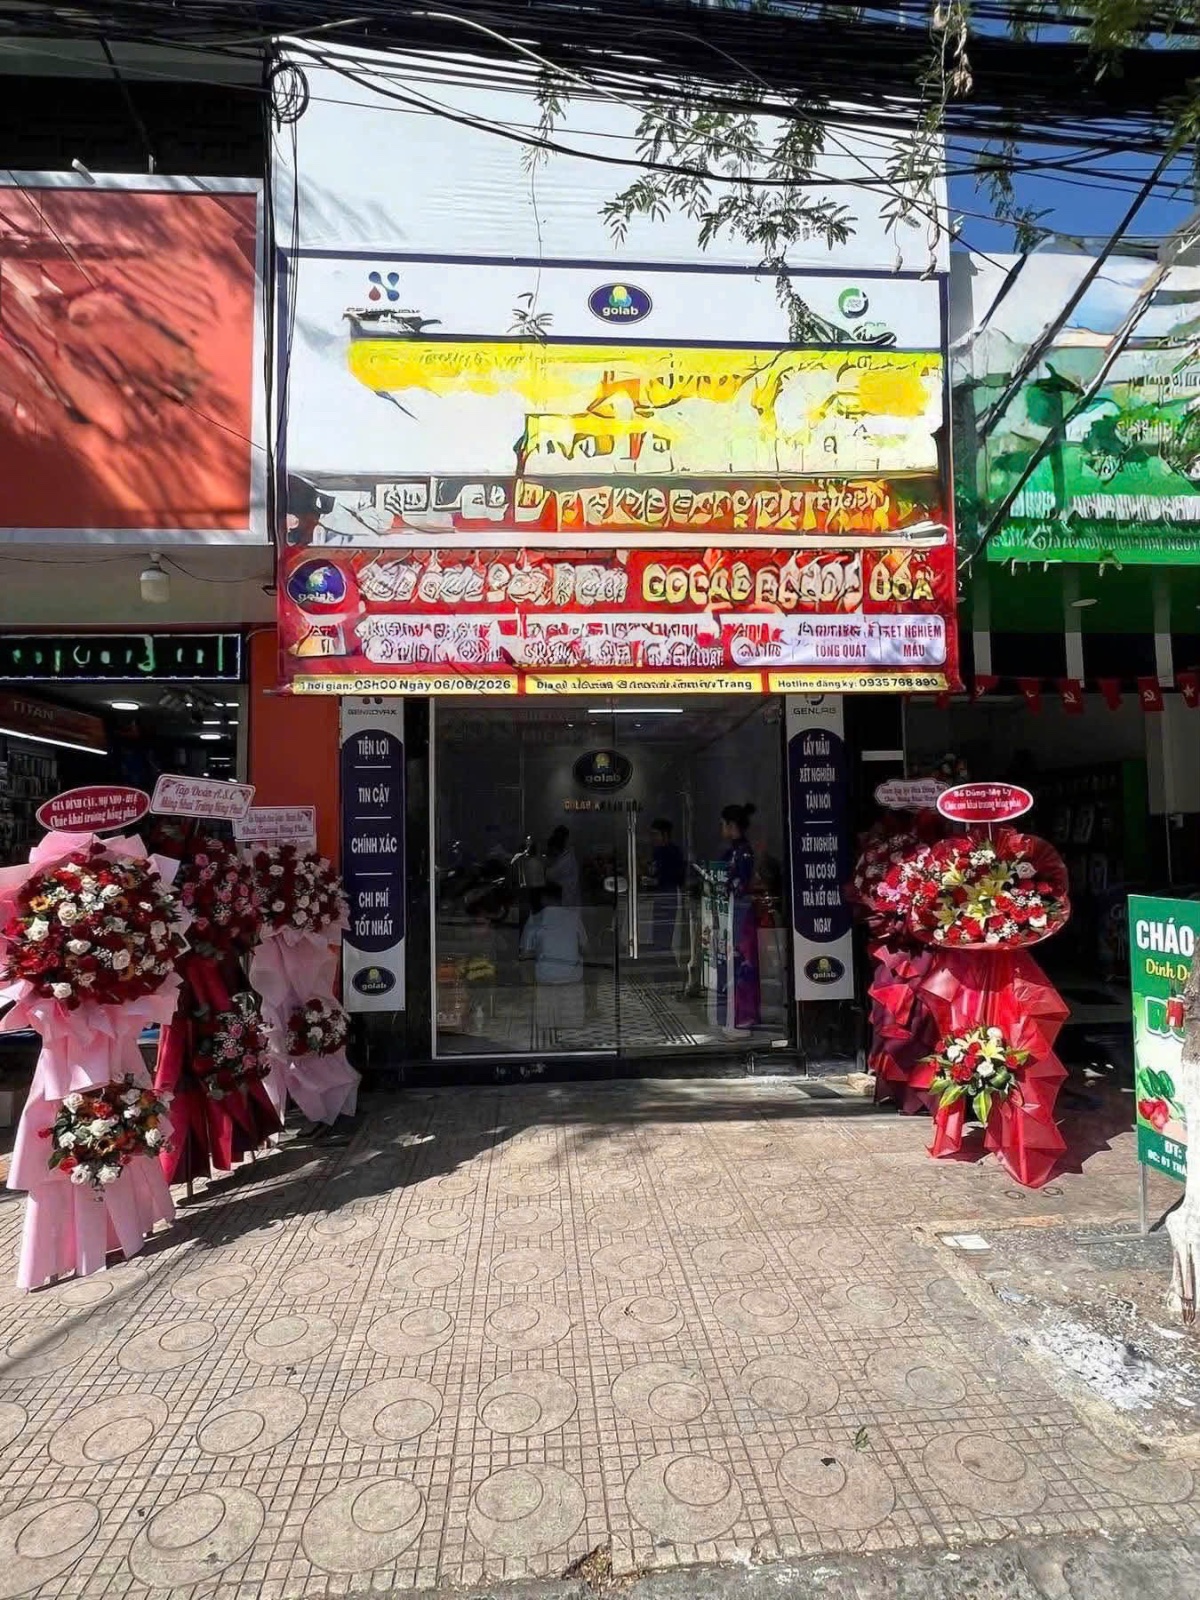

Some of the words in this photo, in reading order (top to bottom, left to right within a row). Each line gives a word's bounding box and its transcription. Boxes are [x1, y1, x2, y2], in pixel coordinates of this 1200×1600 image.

[602, 306, 639, 316] golab
[326, 682, 352, 691] gian:
[400, 680, 431, 692] Ngày
[718, 680, 752, 690] Trang
[778, 680, 814, 688] Hotline
[859, 678, 890, 687] 0935
[358, 736, 374, 760] TIỆN
[376, 737, 389, 760] LỢI
[358, 787, 370, 803] TIN
[372, 783, 390, 808] CẬY
[1002, 788, 1012, 796] Ly
[50, 814, 68, 828] Chúc
[68, 812, 84, 825] khai
[352, 833, 378, 854] CHÍNH
[379, 833, 398, 854] XÁC
[358, 892, 374, 908] CHI
[376, 888, 389, 908] PHÍ
[355, 914, 370, 936] TỐT
[372, 913, 394, 936] NHẤT
[814, 918, 832, 934] NGAY
[1136, 917, 1194, 957] CHÁO
[812, 971, 836, 979] golab
[1146, 958, 1176, 979] Dinh
[361, 982, 387, 991] golab
